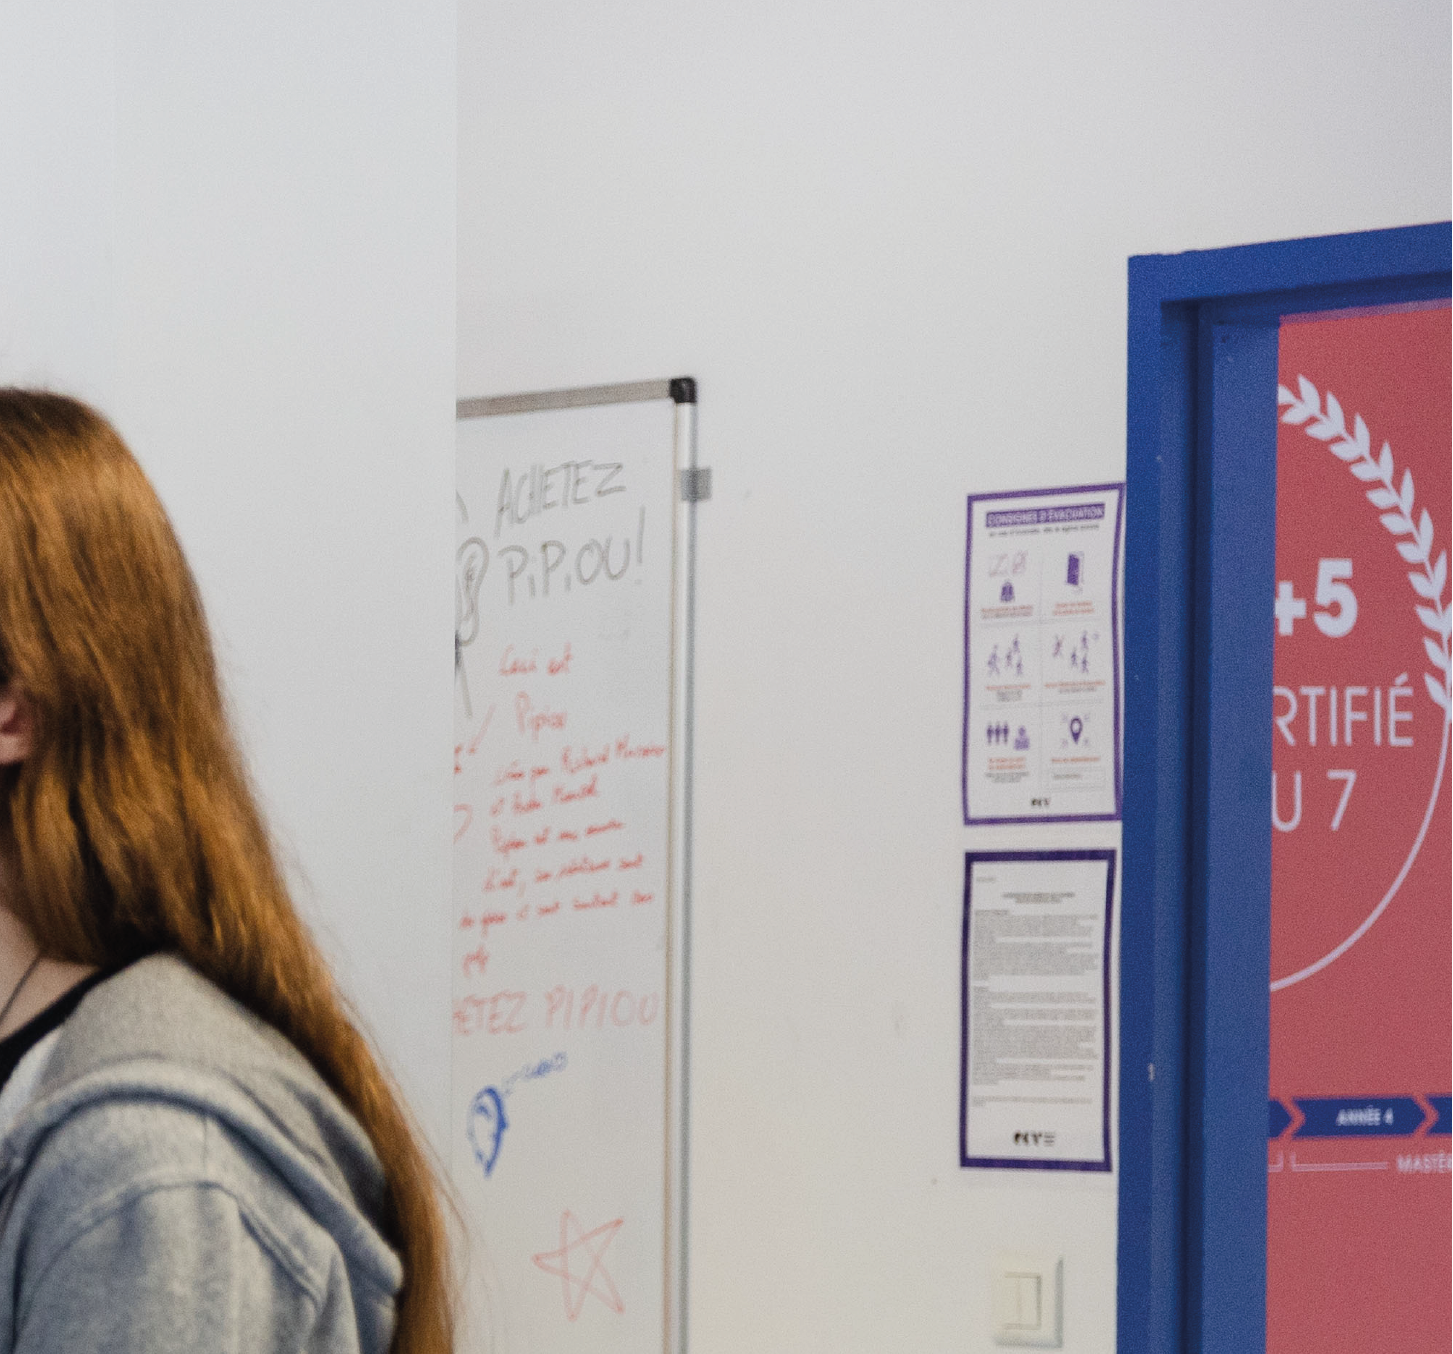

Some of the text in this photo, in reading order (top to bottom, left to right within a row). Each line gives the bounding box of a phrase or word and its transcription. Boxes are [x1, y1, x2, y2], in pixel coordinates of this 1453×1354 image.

[494, 460, 627, 540] ACHETEZ
[1272, 671, 1415, 747] RTIFIÉ
[1271, 771, 1357, 832] U 7
[452, 983, 660, 1036] ETEZ PIPIOU
[1336, 1105, 1381, 1126] ANNÉE
